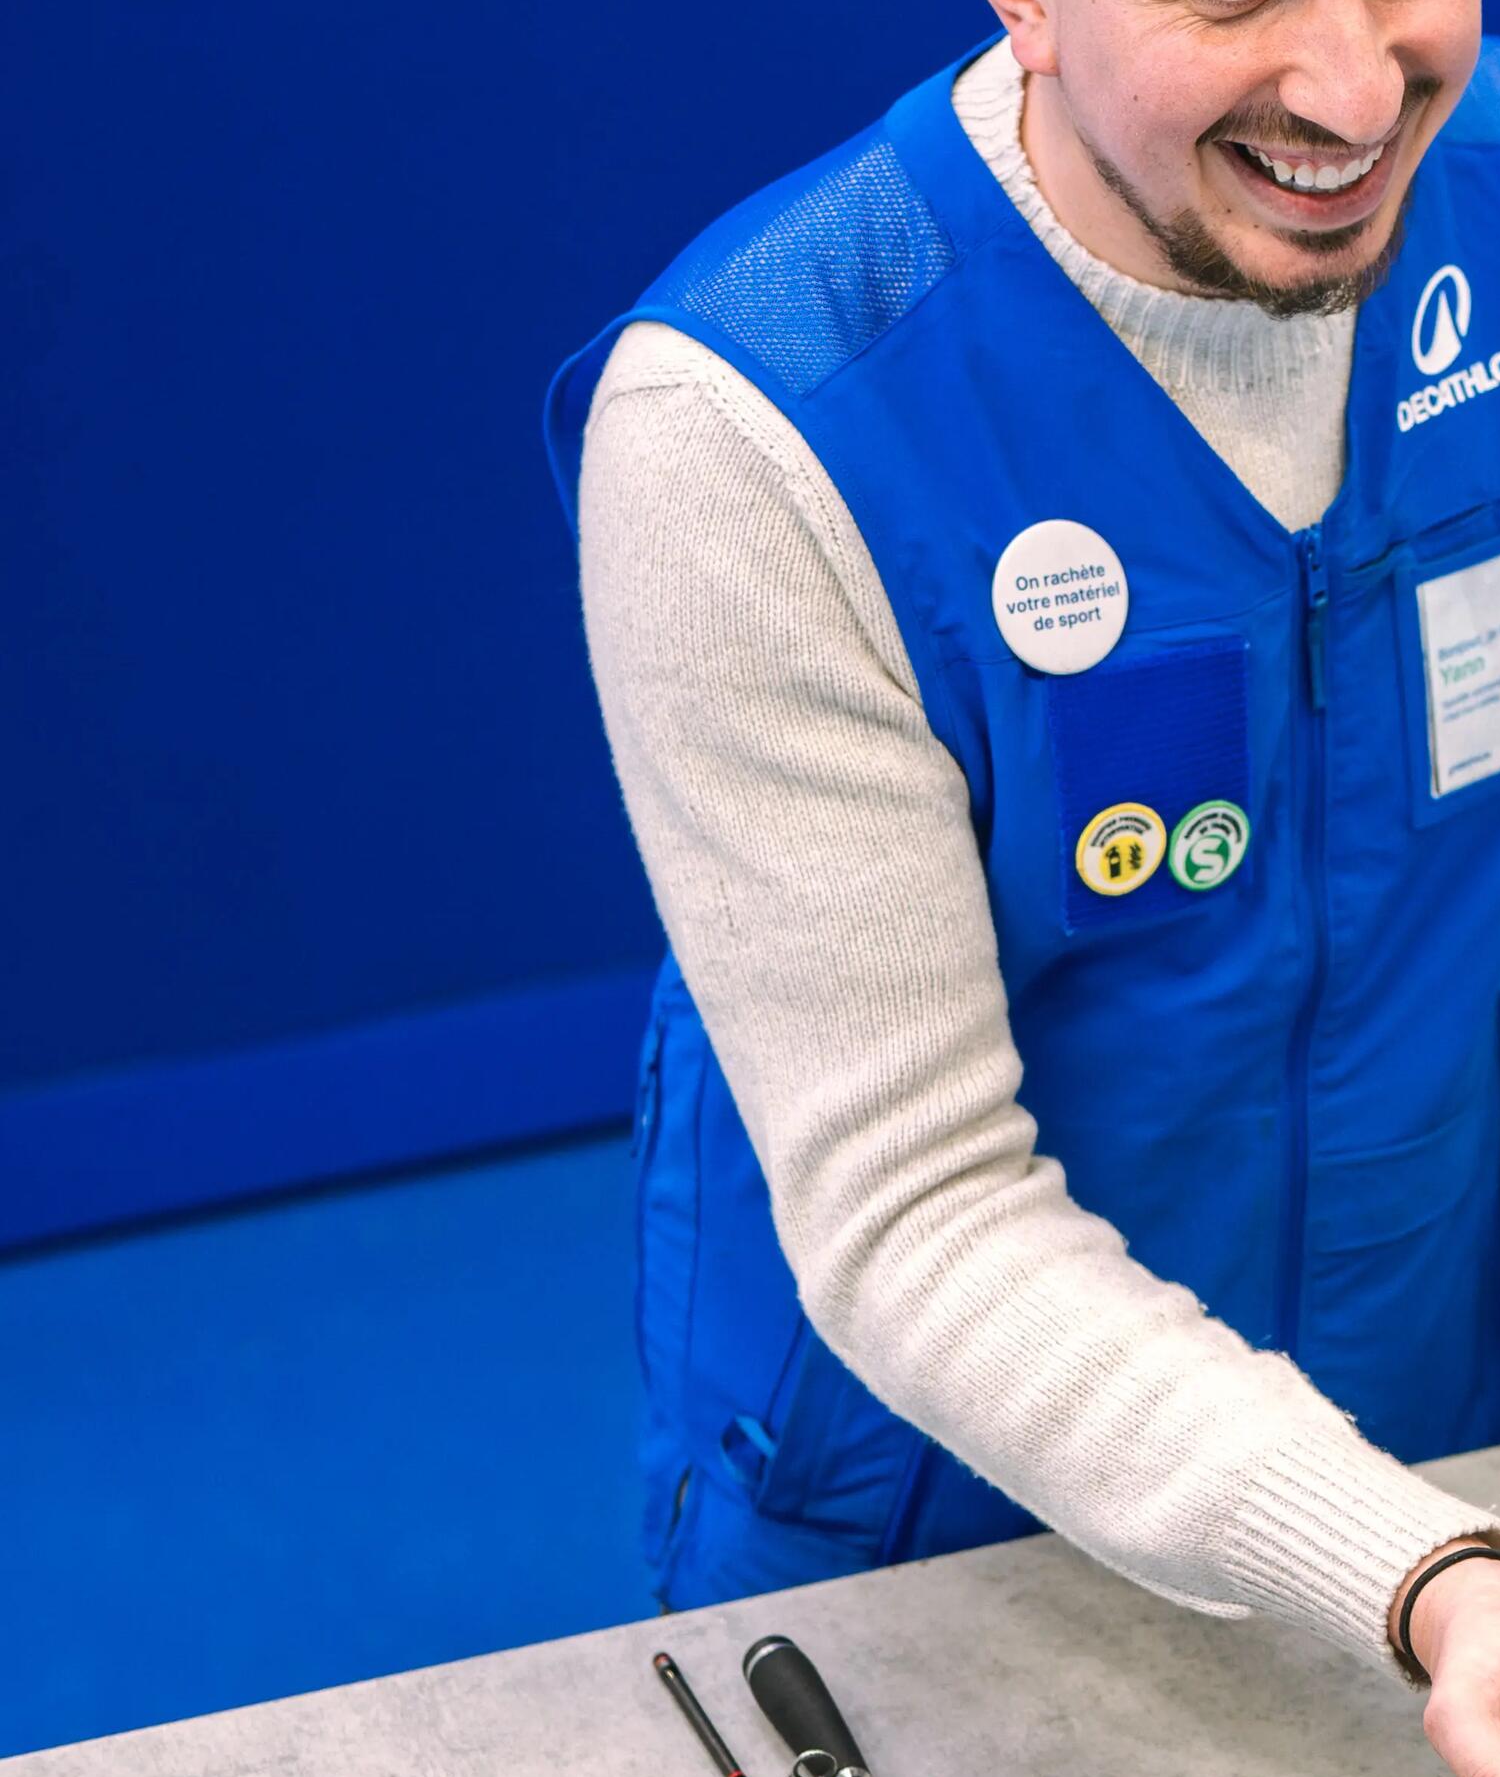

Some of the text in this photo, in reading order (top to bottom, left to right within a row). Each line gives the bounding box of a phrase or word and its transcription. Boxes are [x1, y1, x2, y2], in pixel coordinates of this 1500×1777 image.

[1015, 563, 1106, 592] On rachète
[1006, 581, 1121, 615] votre matériel
[1033, 607, 1102, 632] de sport
